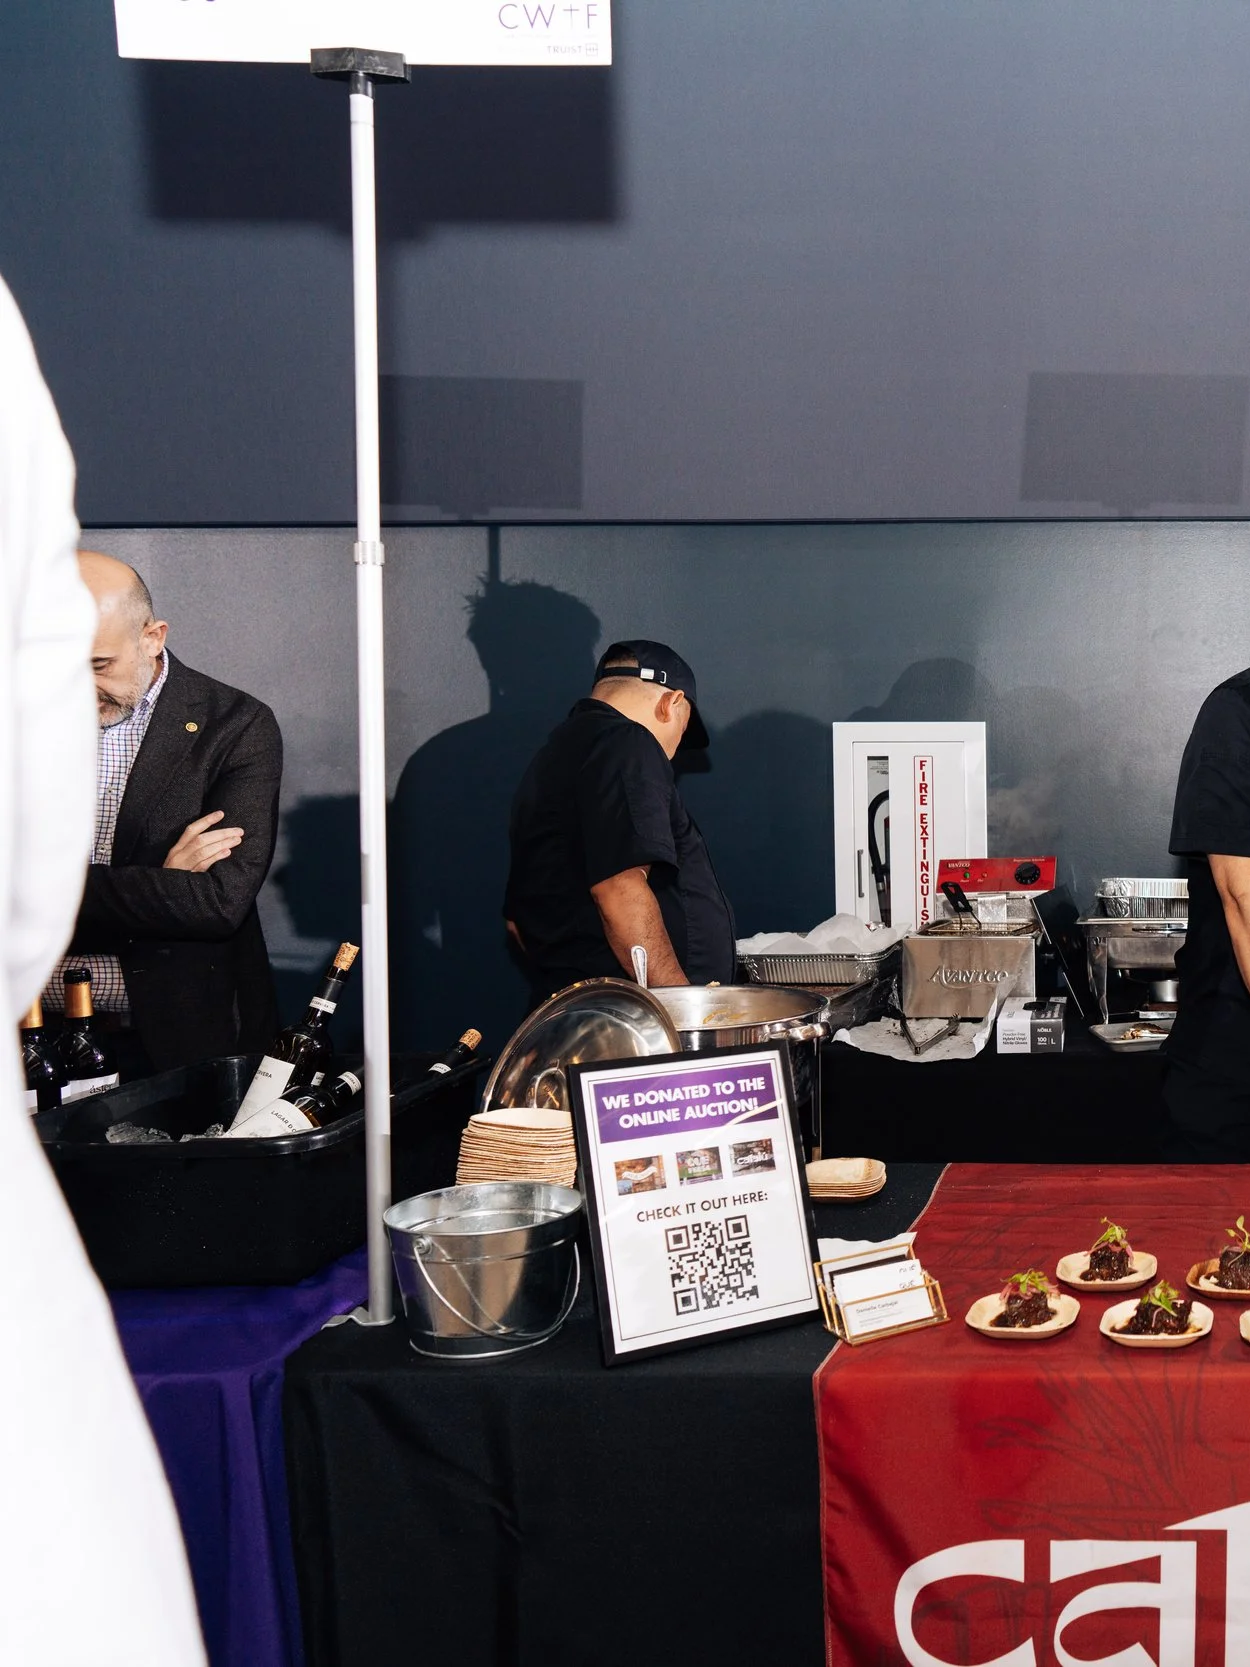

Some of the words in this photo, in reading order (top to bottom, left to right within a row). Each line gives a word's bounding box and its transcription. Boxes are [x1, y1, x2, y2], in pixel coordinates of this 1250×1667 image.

[547, 45, 582, 54] TRUIST
[919, 760, 929, 806] FIRE
[602, 1094, 630, 1110] WE
[633, 1084, 711, 1106] DONATED
[713, 1080, 735, 1096] TO
[737, 1076, 766, 1092] THE
[618, 1108, 681, 1129] ONLINE
[684, 1097, 759, 1120] AUCTION!
[636, 1204, 682, 1223] CHECK
[685, 1202, 696, 1214] IT
[700, 1197, 728, 1212] OUT
[732, 1190, 768, 1206] HERE:
